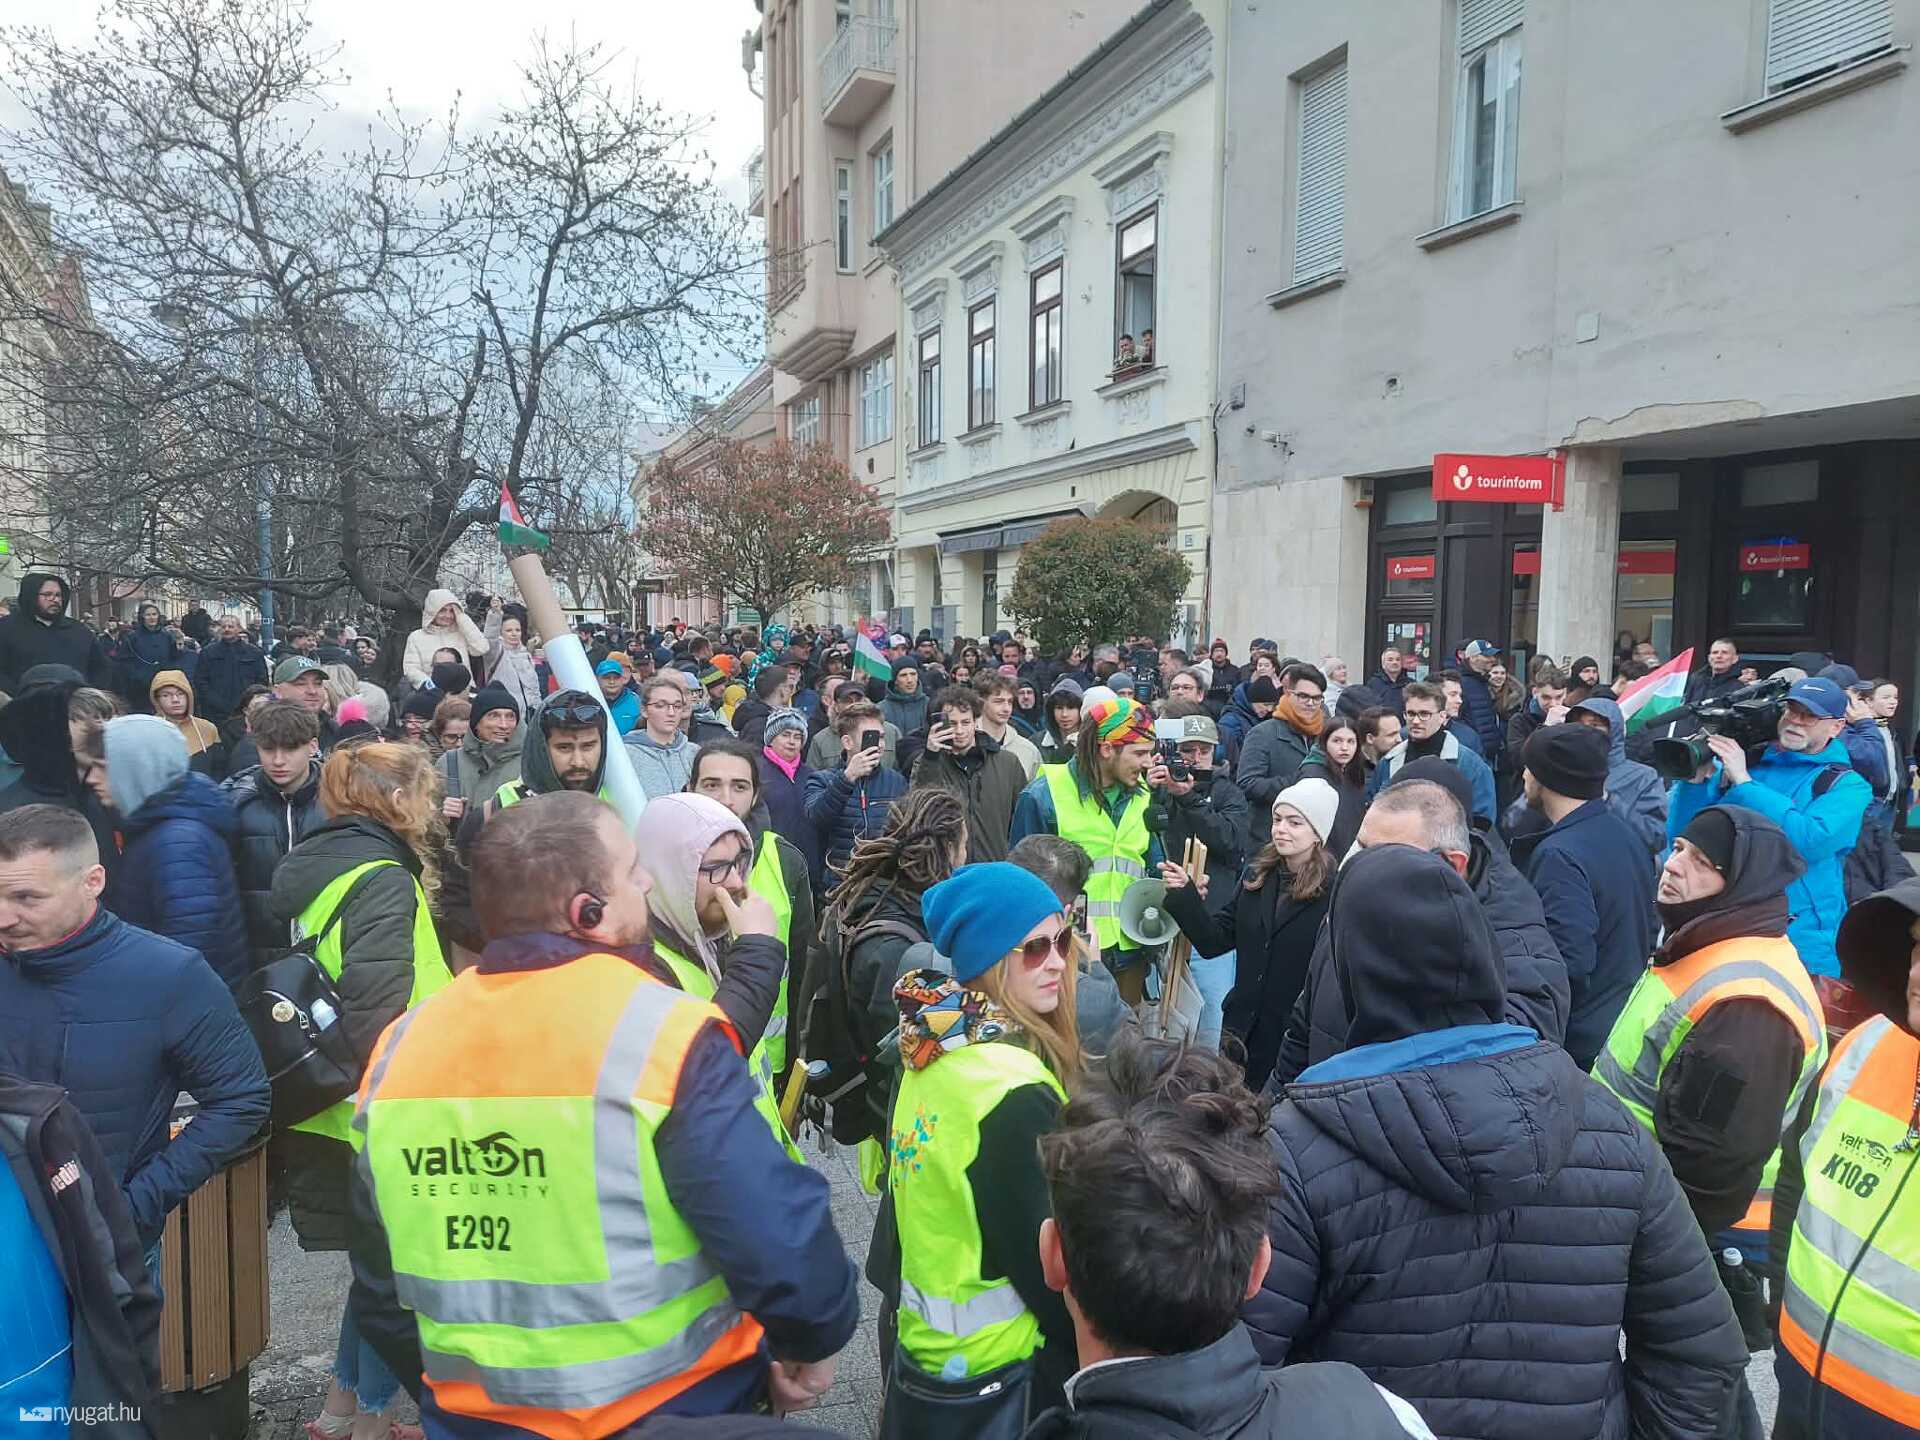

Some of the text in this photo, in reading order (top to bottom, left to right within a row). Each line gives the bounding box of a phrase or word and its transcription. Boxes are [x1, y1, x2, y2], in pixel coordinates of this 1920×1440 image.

[1477, 475, 1542, 489] tourinform
[1820, 1152, 1880, 1198] K108
[411, 1183, 549, 1198] SECURITY
[446, 1214, 511, 1251] E292
